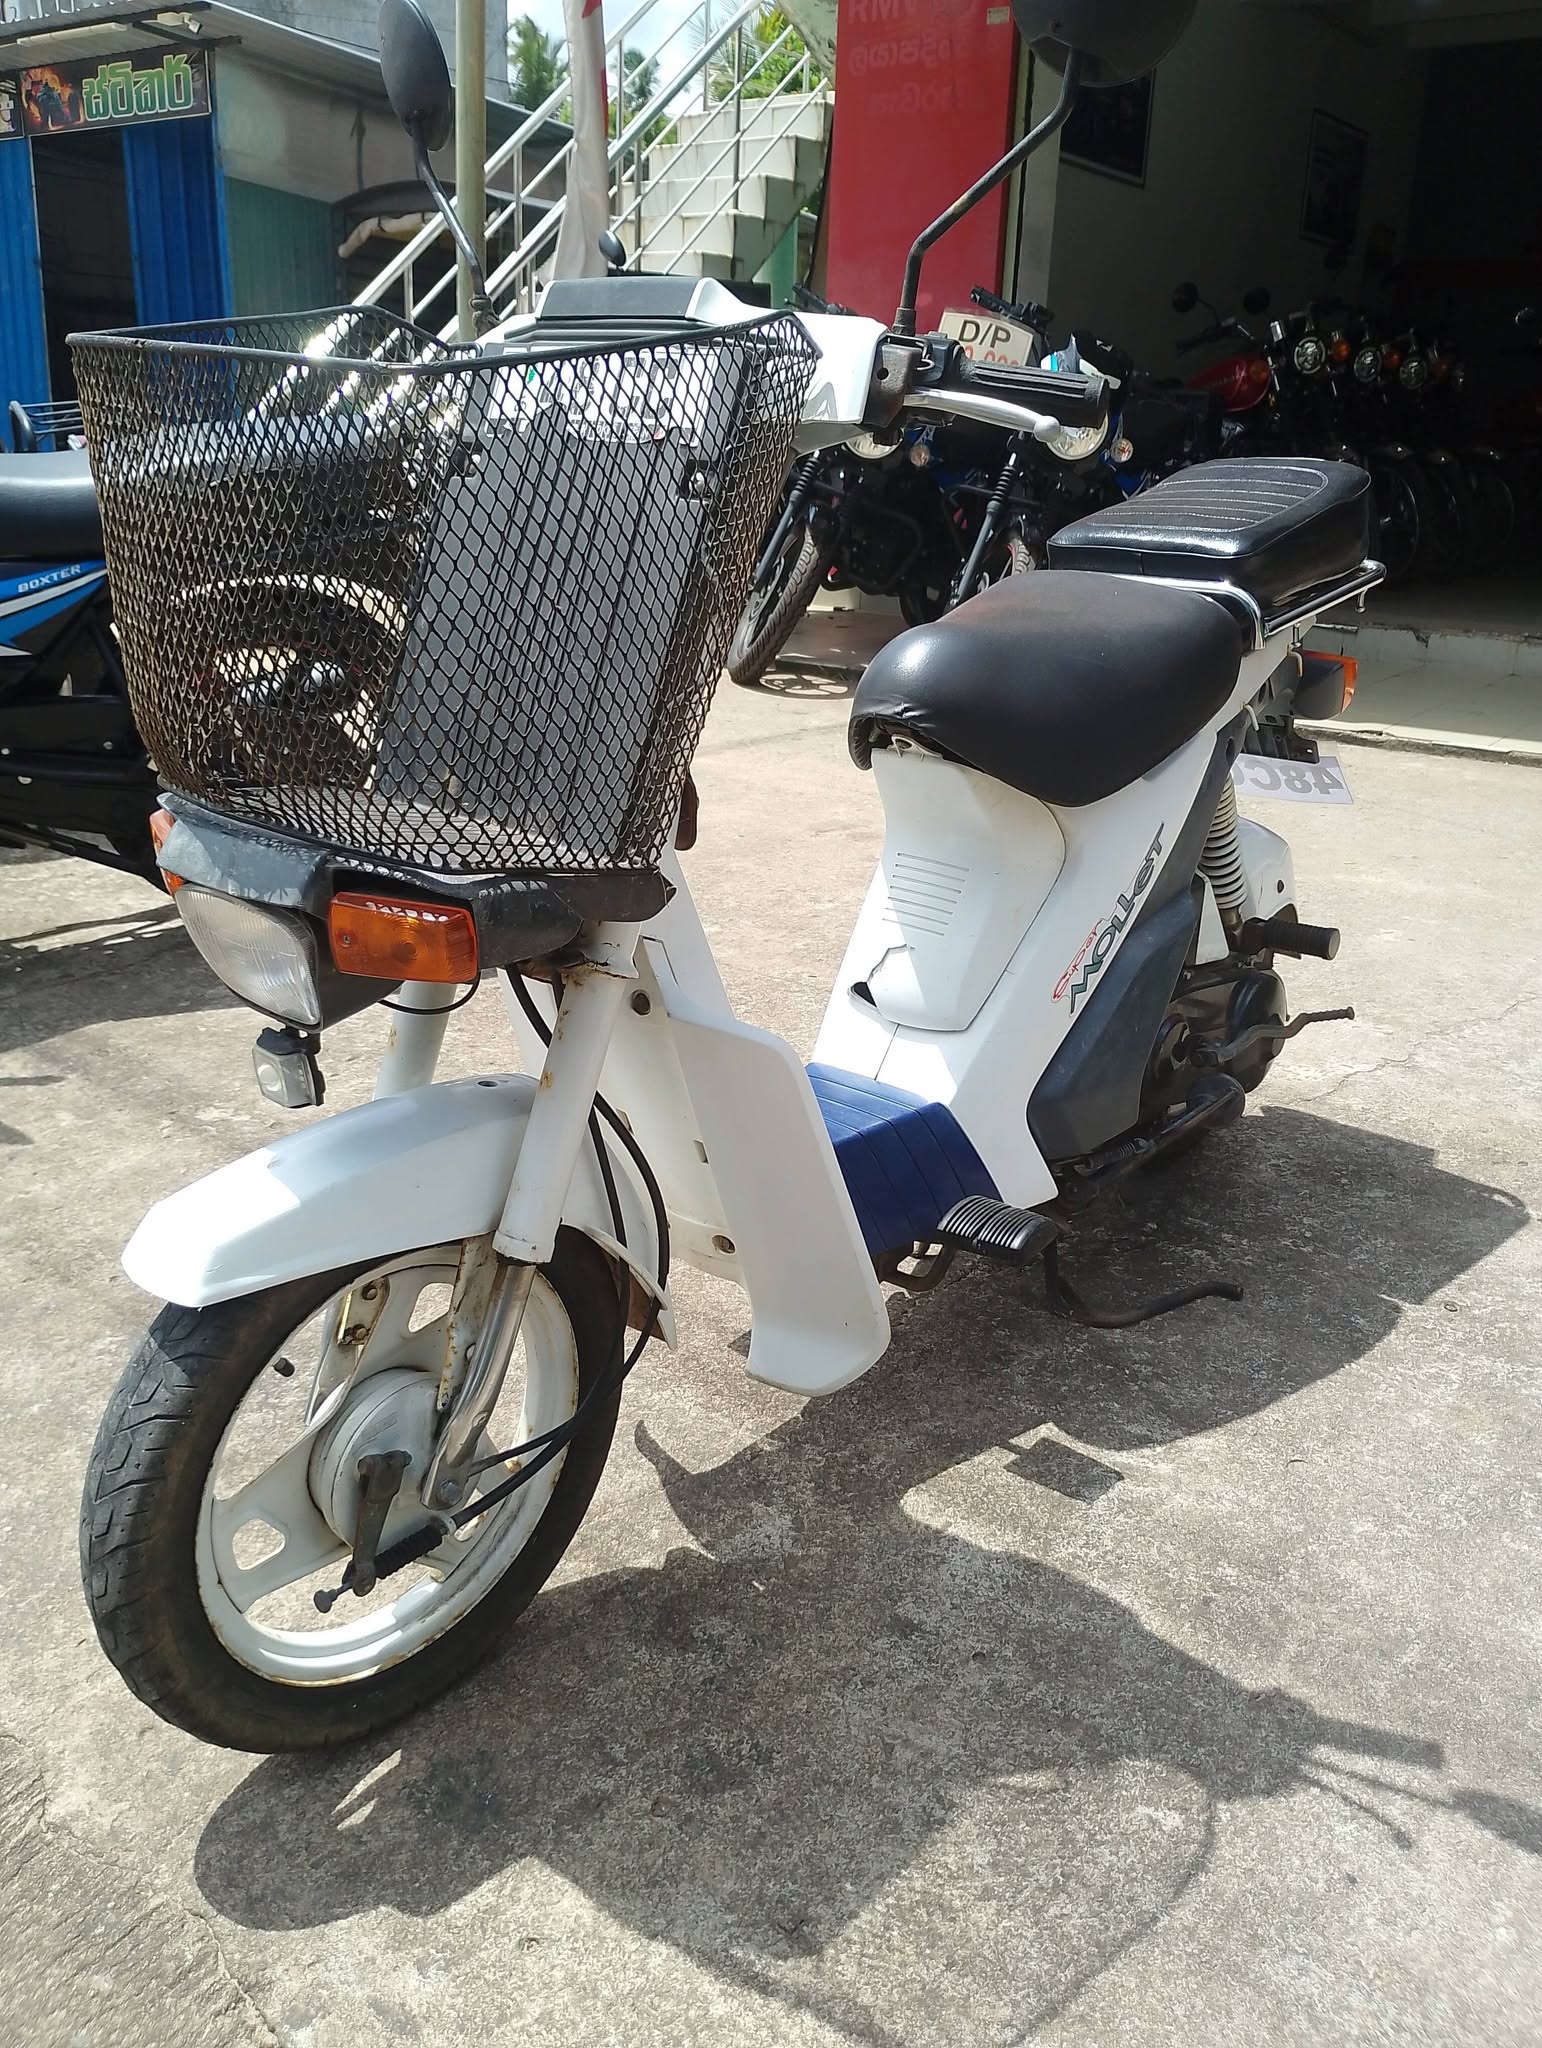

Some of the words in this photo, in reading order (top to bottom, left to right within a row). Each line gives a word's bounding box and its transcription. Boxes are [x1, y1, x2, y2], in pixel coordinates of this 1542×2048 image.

[958, 319, 1011, 349] D/P
[18, 564, 81, 593] BOXTER
[1052, 918, 1103, 1000] Super
